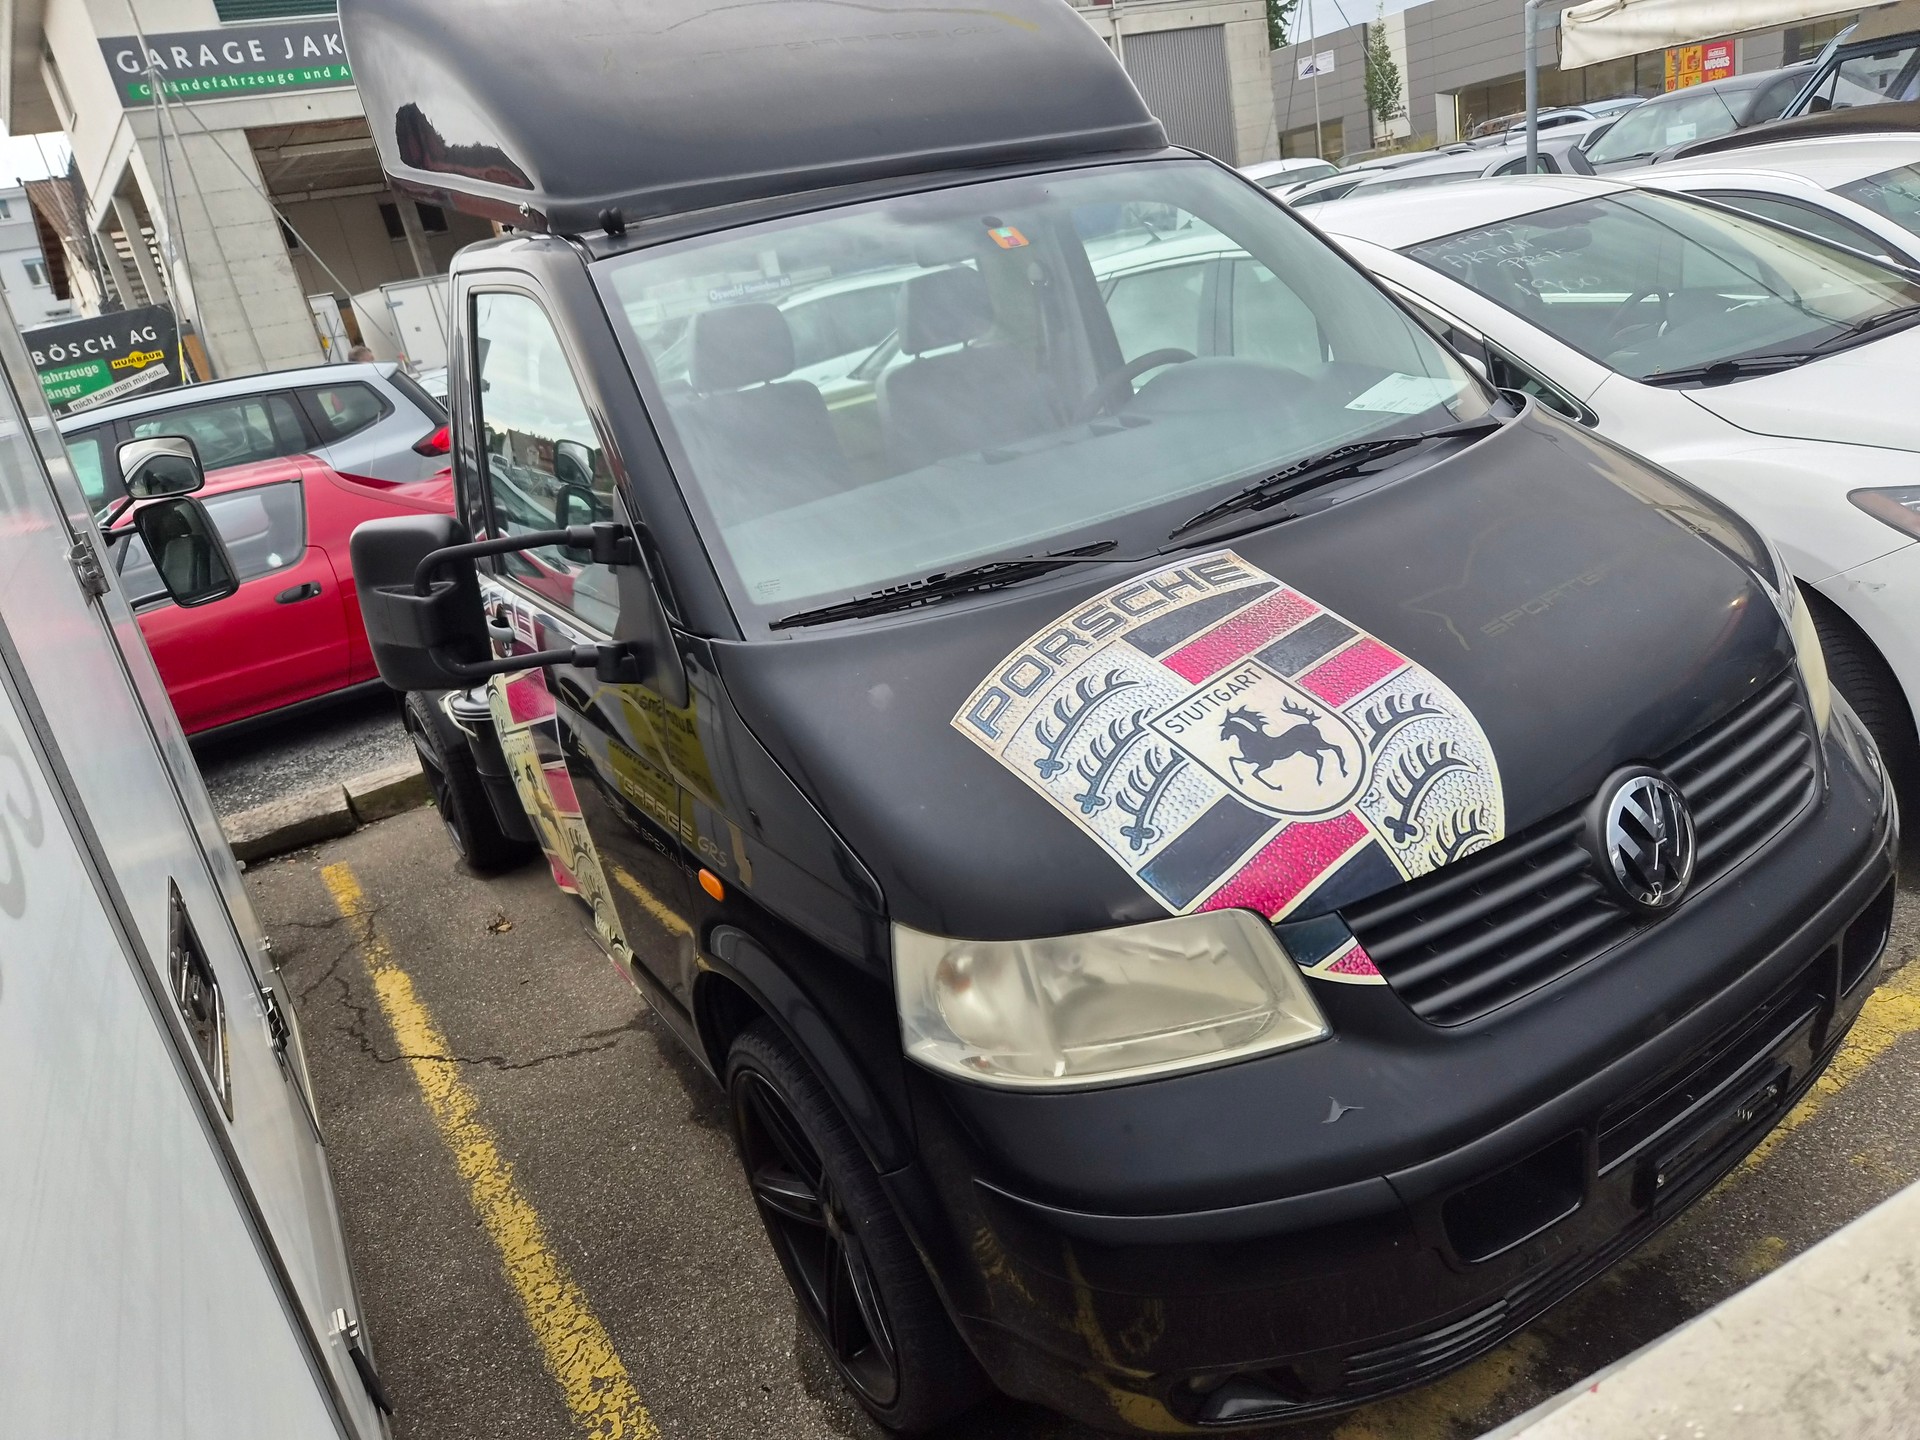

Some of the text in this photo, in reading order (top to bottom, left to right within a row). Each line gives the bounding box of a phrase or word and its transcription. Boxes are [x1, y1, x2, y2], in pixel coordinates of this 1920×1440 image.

[116, 40, 266, 73] GARAGE
[139, 73, 295, 96] Gländefahrzeuge
[303, 67, 331, 80] und
[31, 326, 157, 366] BÖSCH AG
[113, 351, 162, 367] HUMBAUR
[72, 399, 94, 411] mich
[94, 389, 114, 402] kann
[115, 381, 132, 393] man
[966, 557, 1256, 741] PORSCHE
[1165, 667, 1262, 734] STUTTGART
